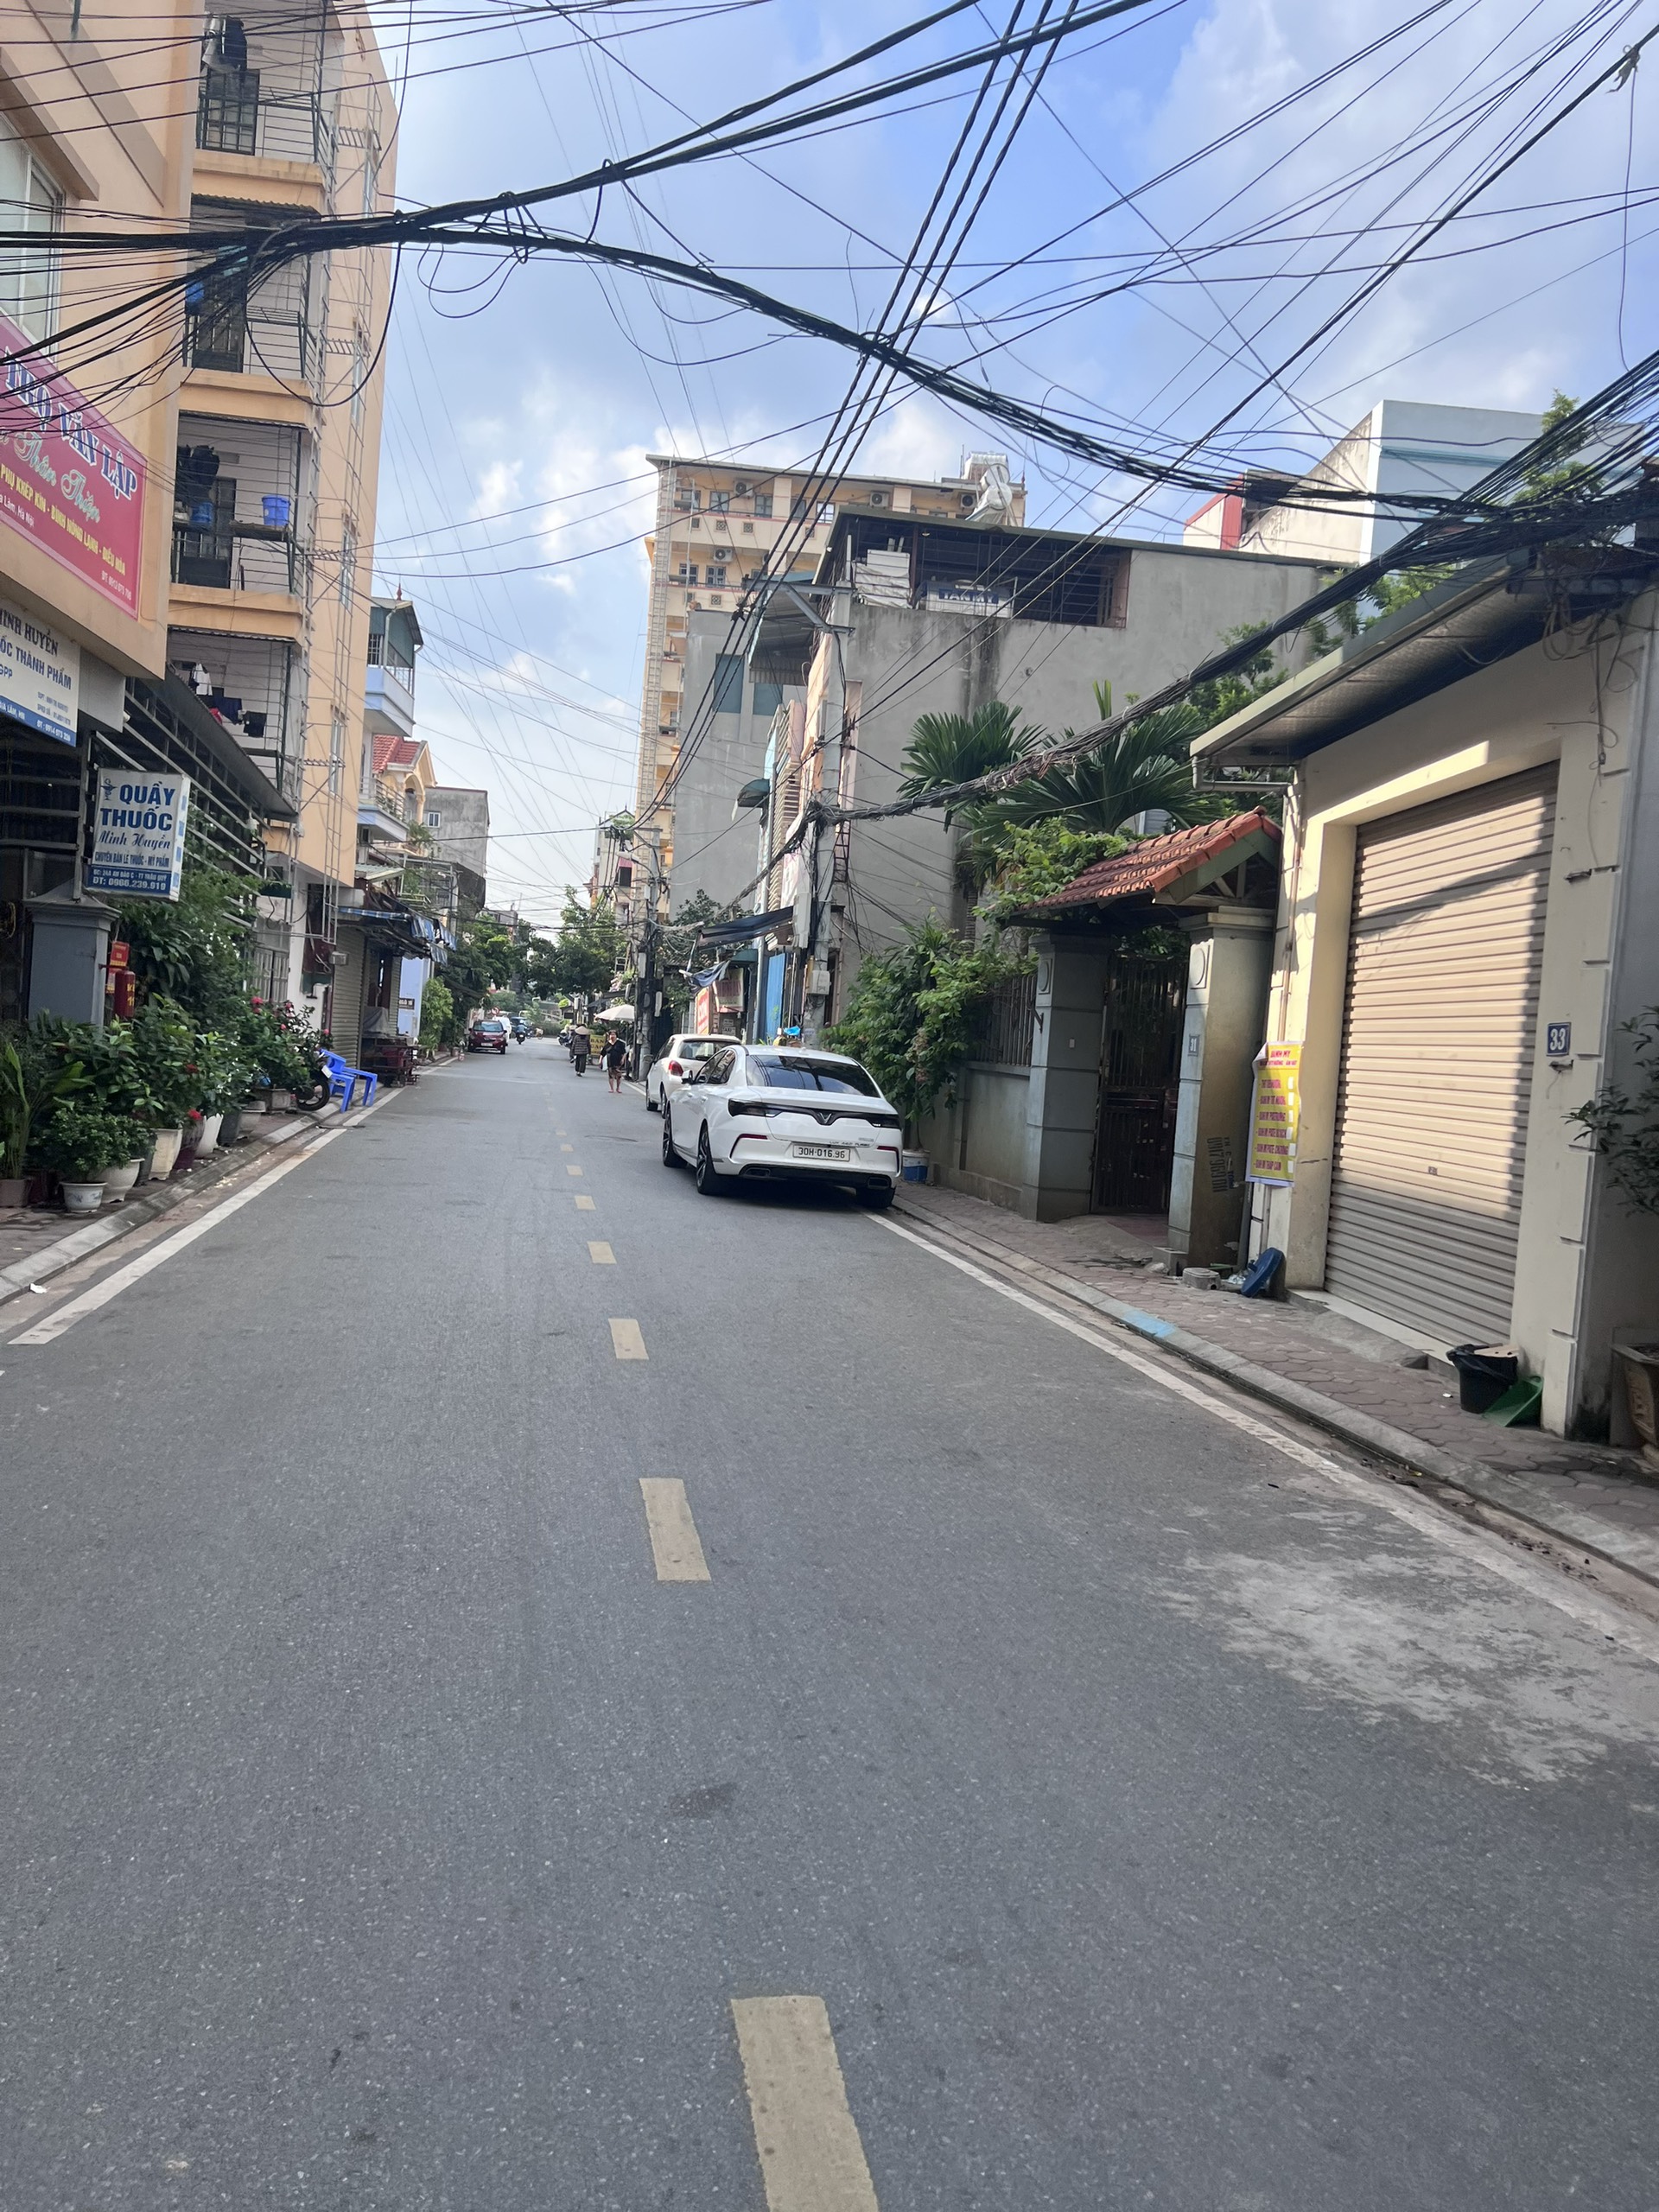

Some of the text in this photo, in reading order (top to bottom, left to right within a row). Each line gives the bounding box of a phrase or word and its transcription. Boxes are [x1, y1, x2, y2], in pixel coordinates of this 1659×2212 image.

[101, 443, 138, 500] LẬP
[119, 780, 175, 806] QUẦY
[100, 805, 173, 831] THUỐC
[99, 830, 127, 846] Minh
[1190, 1038, 1198, 1052] 31
[1549, 1028, 1566, 1051] 33
